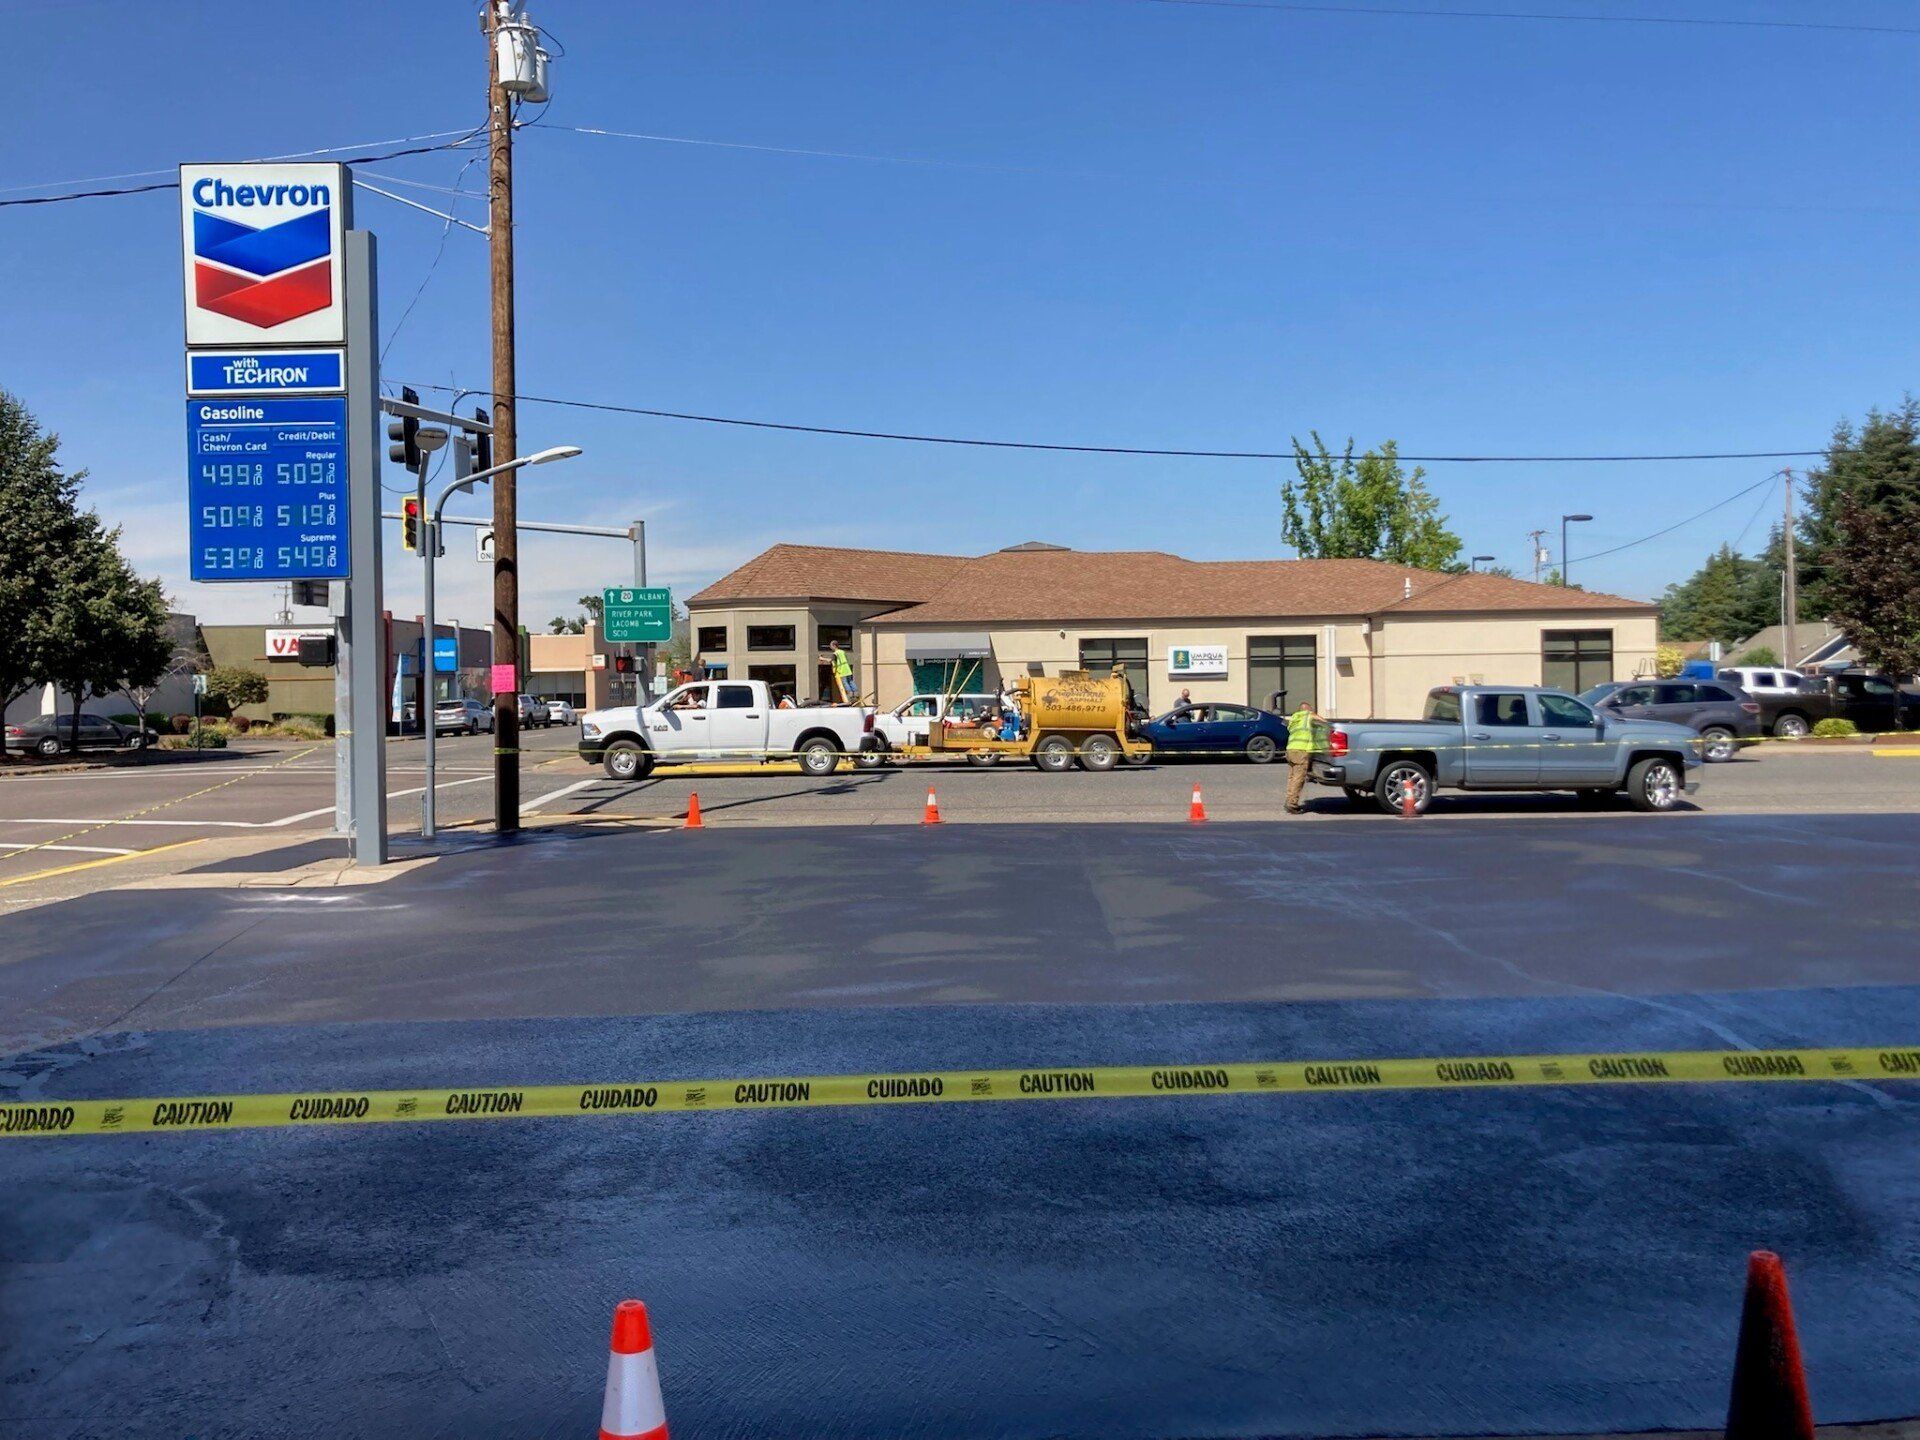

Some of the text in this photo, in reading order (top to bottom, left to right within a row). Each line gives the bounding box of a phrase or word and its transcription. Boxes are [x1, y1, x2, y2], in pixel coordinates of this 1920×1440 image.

[192, 177, 330, 207] Chevron
[232, 357, 259, 368] with
[223, 366, 309, 386] TECHRON
[200, 405, 265, 420] Gasoline
[202, 433, 231, 443] Cash/
[277, 431, 336, 441] Credit/Debit
[202, 442, 267, 452] Chevron Card
[305, 451, 336, 461] Regular
[318, 492, 336, 500] Plus
[300, 533, 337, 543] Supreme
[622, 592, 666, 601] 20 ALBANY
[611, 610, 653, 618] RIVER PARK
[611, 620, 640, 628] LACOMB
[153, 1101, 233, 1126] CAUTION
[289, 1097, 370, 1119] CUIDADO
[445, 1092, 523, 1114] CAUTION
[579, 1087, 658, 1110] CUIDADO
[734, 1082, 810, 1103] CAUTION
[867, 1076, 943, 1099] CUIDADO
[1019, 1072, 1095, 1093] CAUTION
[1151, 1069, 1230, 1090] CUIDADO
[1303, 1065, 1381, 1085] CAUTION
[1435, 1060, 1515, 1082] CUIDADO
[1588, 1056, 1669, 1078] CAUTION
[1722, 1054, 1805, 1076] CUIDADO
